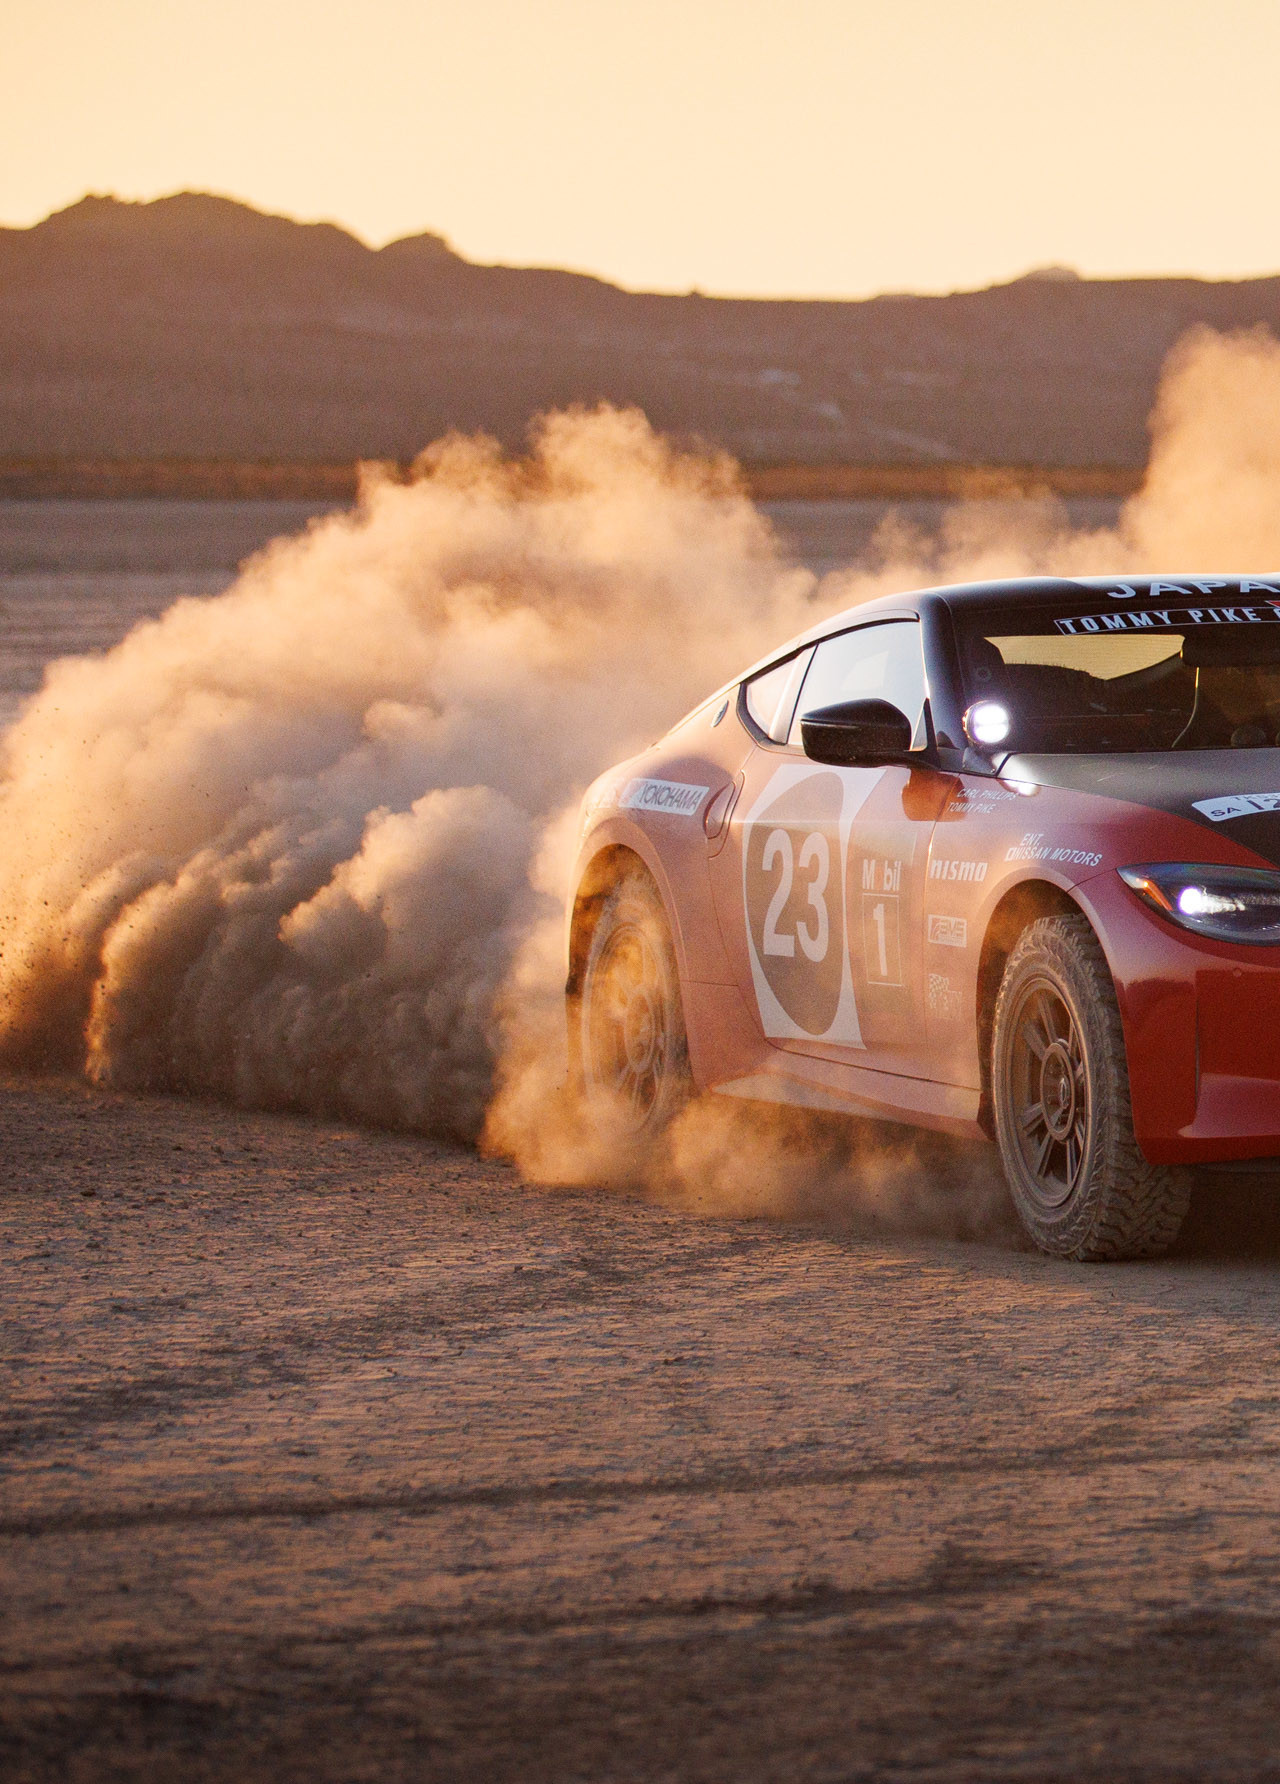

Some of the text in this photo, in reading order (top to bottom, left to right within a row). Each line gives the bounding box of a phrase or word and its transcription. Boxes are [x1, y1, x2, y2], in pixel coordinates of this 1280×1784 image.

[1059, 610, 1171, 635] TOMMY
[1188, 607, 1262, 624] PIKE
[957, 788, 980, 799] CARL
[947, 802, 996, 814] TOMMY PIKE
[1050, 847, 1103, 867] MOTORS
[929, 859, 989, 883] nismo
[761, 828, 830, 963] 23
[872, 903, 888, 977] 1
